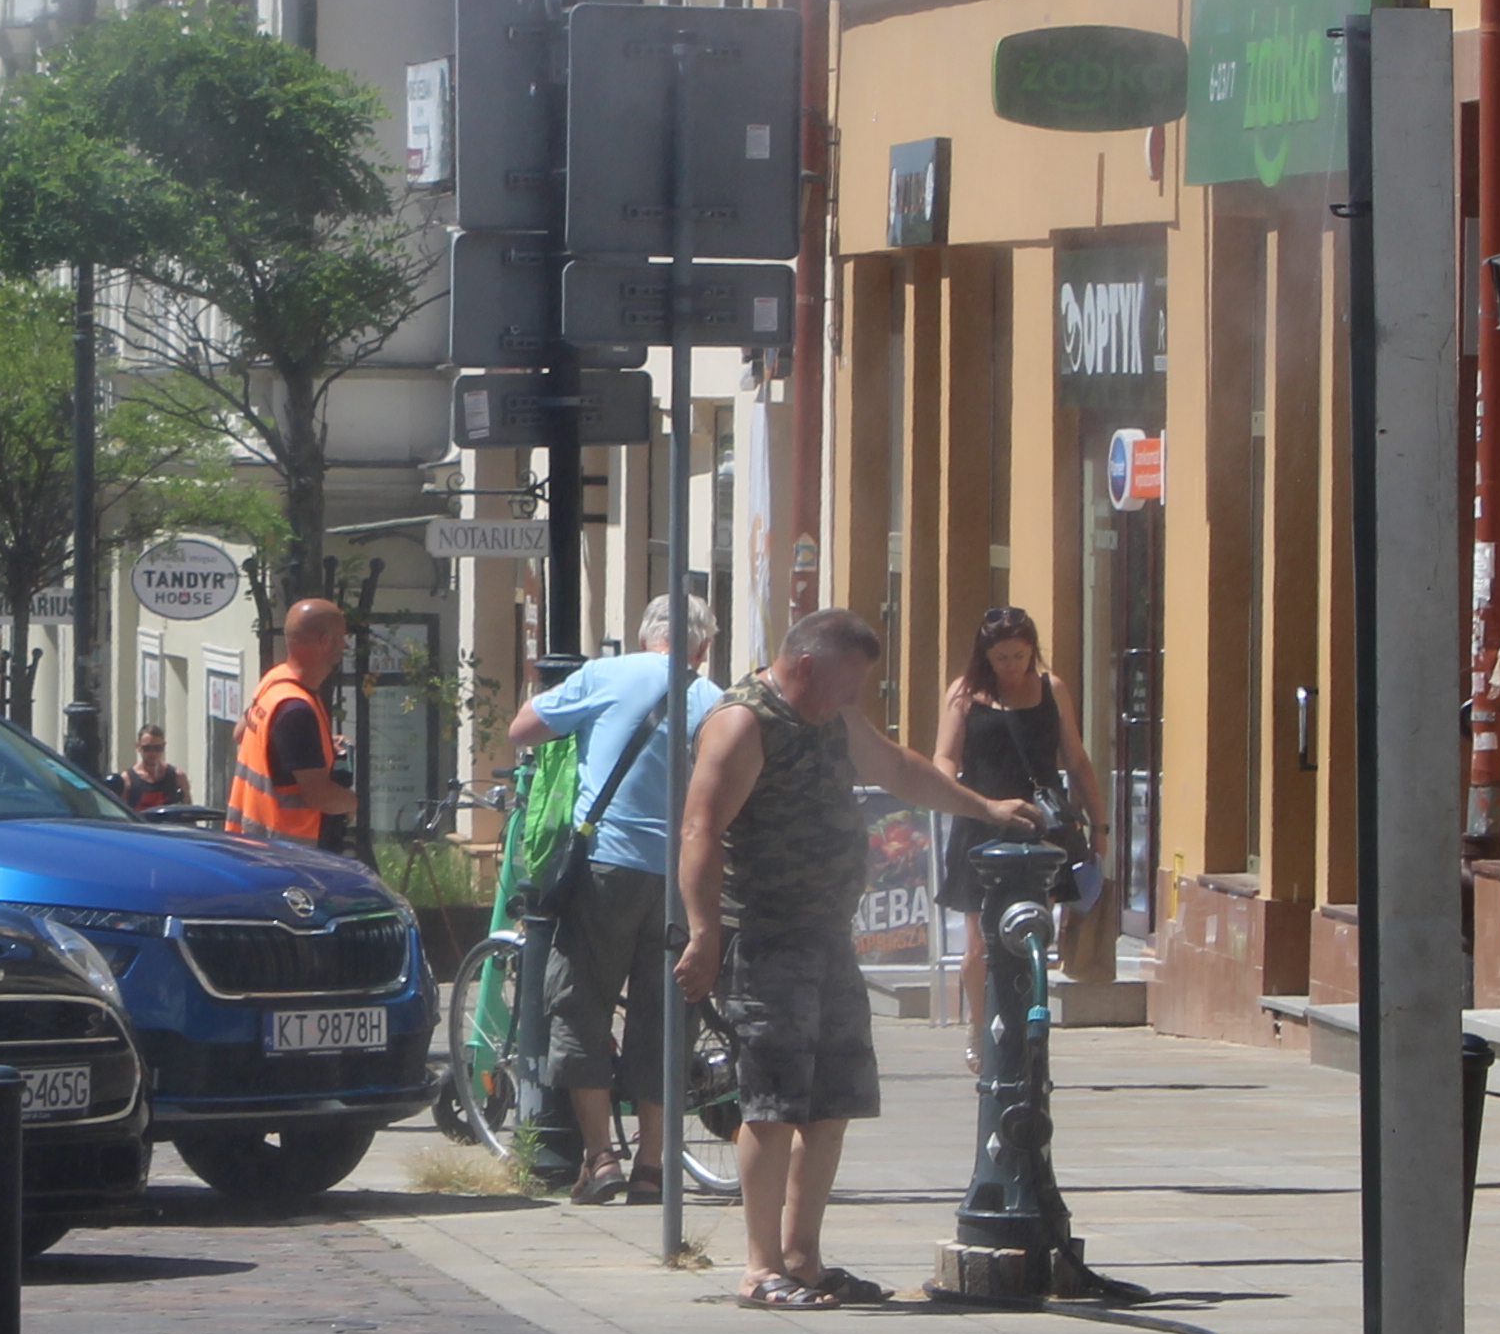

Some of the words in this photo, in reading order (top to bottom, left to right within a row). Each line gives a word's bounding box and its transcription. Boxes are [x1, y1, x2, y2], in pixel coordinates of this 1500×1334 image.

[1243, 4, 1322, 130] żabka
[1083, 282, 1143, 376] OPTYK
[439, 527, 545, 550] NOTARIUSZ
[143, 570, 225, 589] TANDYR
[278, 1013, 309, 1047] KT
[316, 1010, 383, 1046] 9878H
[21, 1070, 88, 1109] 5465G
